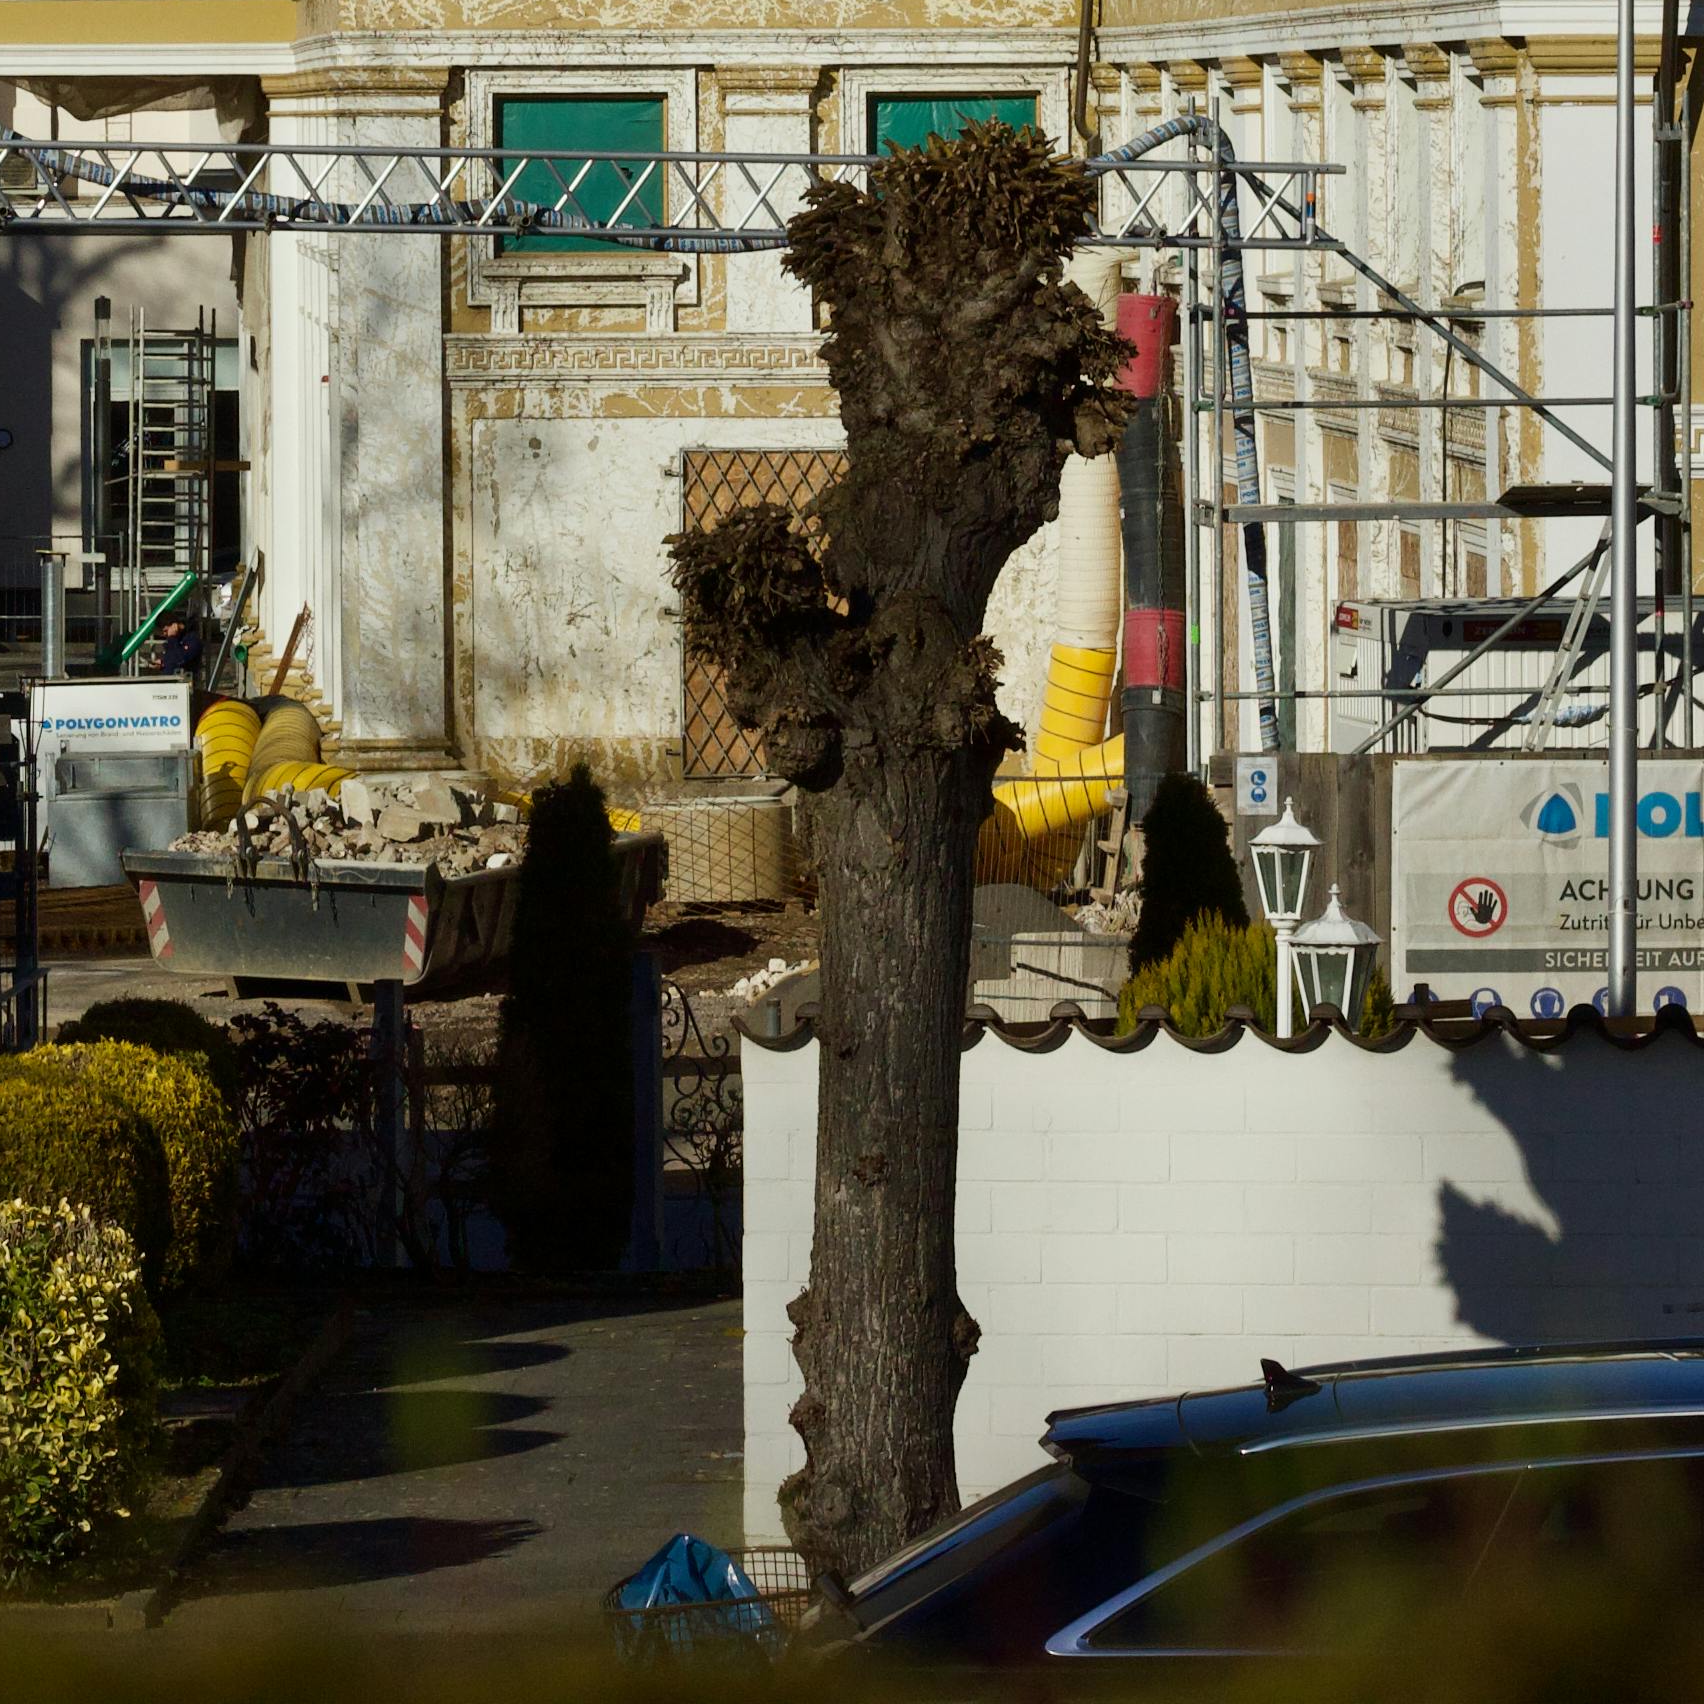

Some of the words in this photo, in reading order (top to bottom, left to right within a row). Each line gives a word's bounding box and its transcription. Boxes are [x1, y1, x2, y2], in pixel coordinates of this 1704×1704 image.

[55, 715, 181, 730] POLYGONVATRO
[1559, 879, 1693, 901] ACHUNG
[1559, 913, 1610, 931] Zutrit
[1635, 913, 1653, 931] ür
[1545, 951, 1662, 968] SICHEEIT
